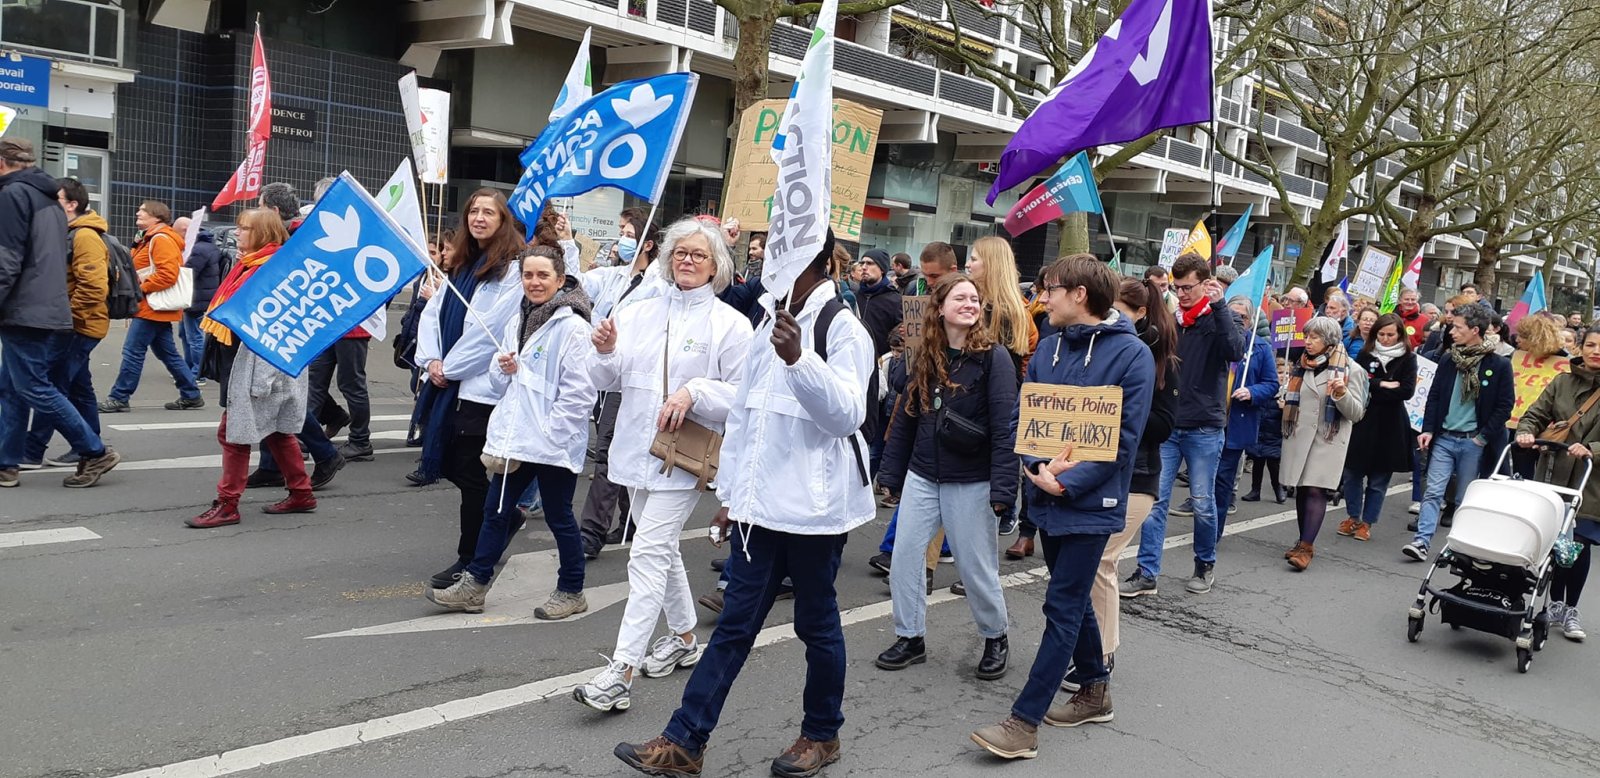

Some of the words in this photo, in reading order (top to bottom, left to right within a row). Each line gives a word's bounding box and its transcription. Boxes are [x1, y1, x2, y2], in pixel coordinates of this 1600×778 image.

[0, 68, 24, 78] avail
[0, 81, 36, 93] oraire
[270, 108, 306, 121] IDENCE
[272, 125, 313, 138] BEFFROI
[593, 216, 614, 226] Freeze
[588, 228, 608, 237] SHOP
[1162, 244, 1183, 255] NATUR
[907, 322, 922, 337] C'E
[1024, 418, 1059, 440] ARE
[1079, 420, 1119, 448] WORST
